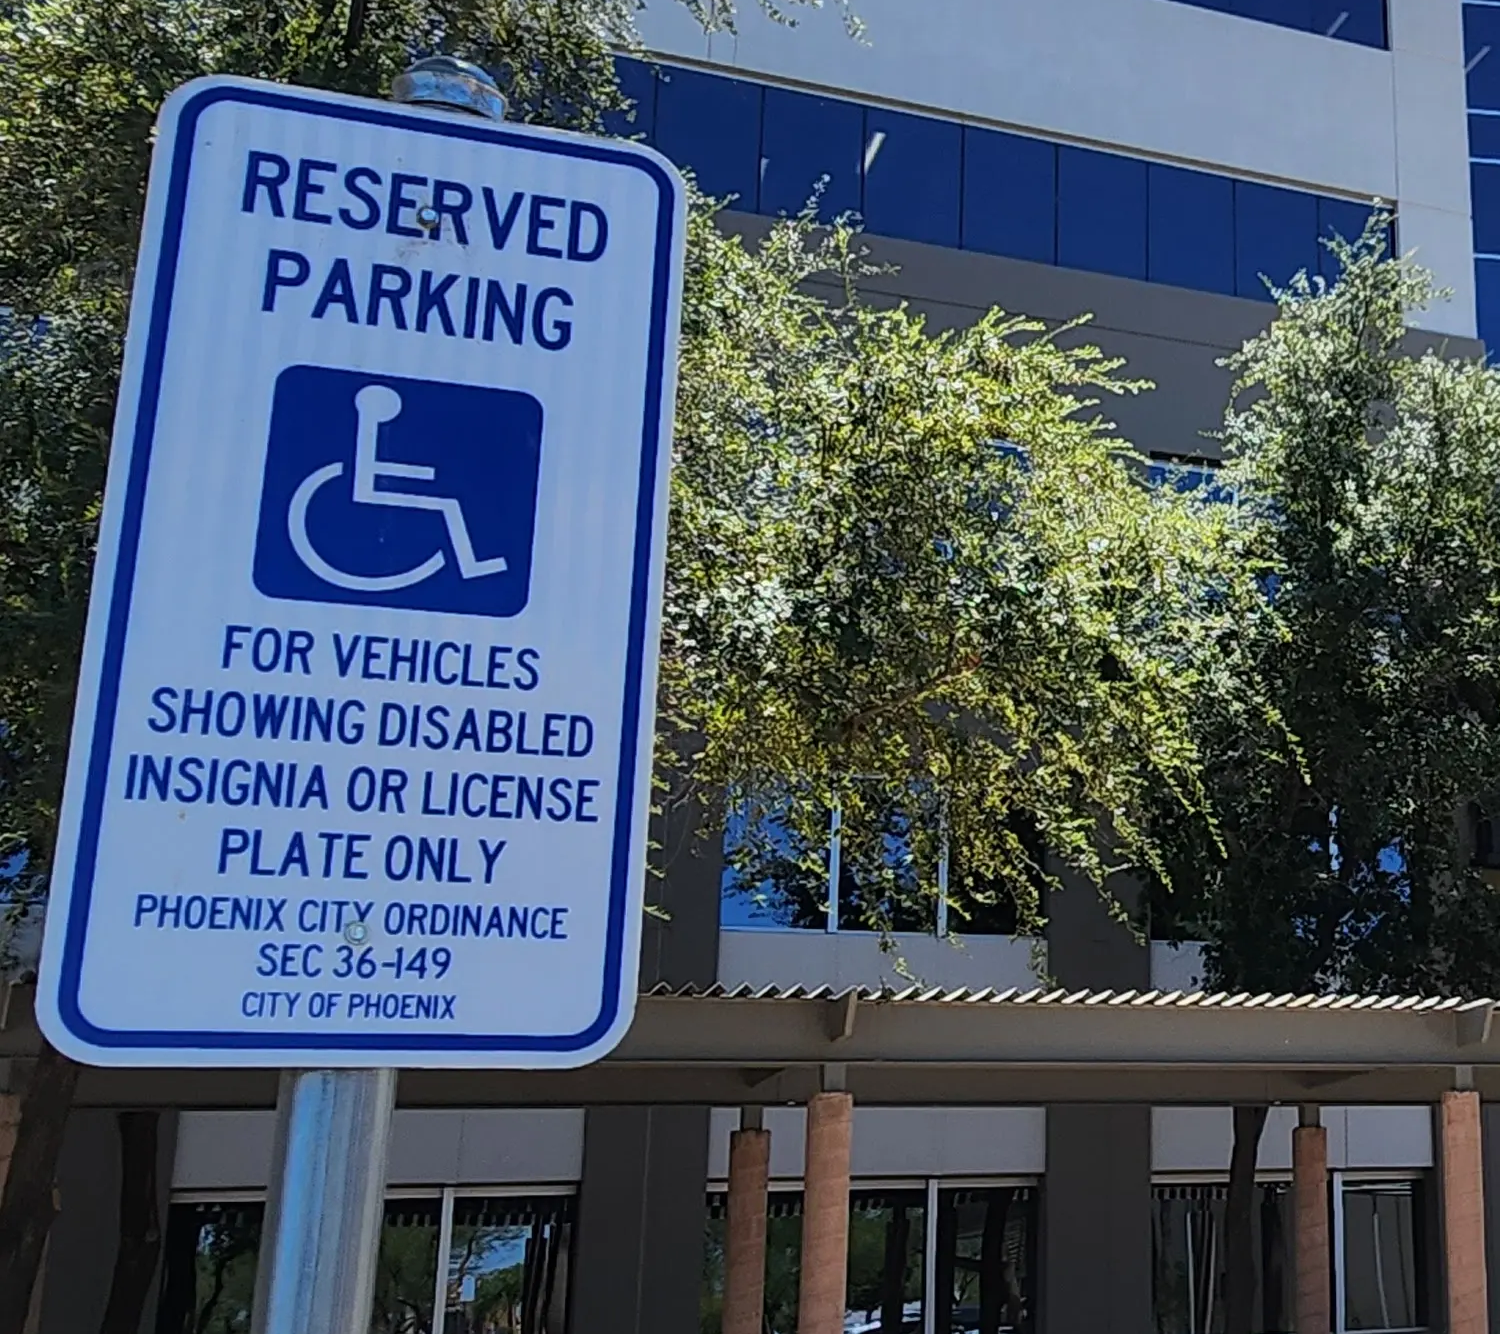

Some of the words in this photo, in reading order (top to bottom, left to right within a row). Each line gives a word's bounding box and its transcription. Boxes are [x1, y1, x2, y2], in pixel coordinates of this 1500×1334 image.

[240, 149, 609, 263] RESERVED
[261, 248, 574, 352] PARKING
[221, 624, 315, 676] FOR
[332, 633, 541, 691] VEHICLES
[147, 686, 366, 745] SHOWING
[377, 702, 594, 758] DISABLED
[123, 754, 329, 810] INSIGNIA
[346, 765, 409, 814] OR
[421, 771, 601, 823] LICENSE
[217, 827, 372, 880] PLATE
[384, 834, 507, 884] ONLY
[133, 893, 288, 932] PHOENIX
[298, 899, 375, 935] CITY
[384, 901, 569, 940] ORDINANCE
[256, 942, 324, 978] SEC
[332, 944, 452, 980] 36-149
[241, 991, 301, 1018] CITY
[308, 992, 343, 1019] OF
[347, 993, 457, 1020] PHOENIX
